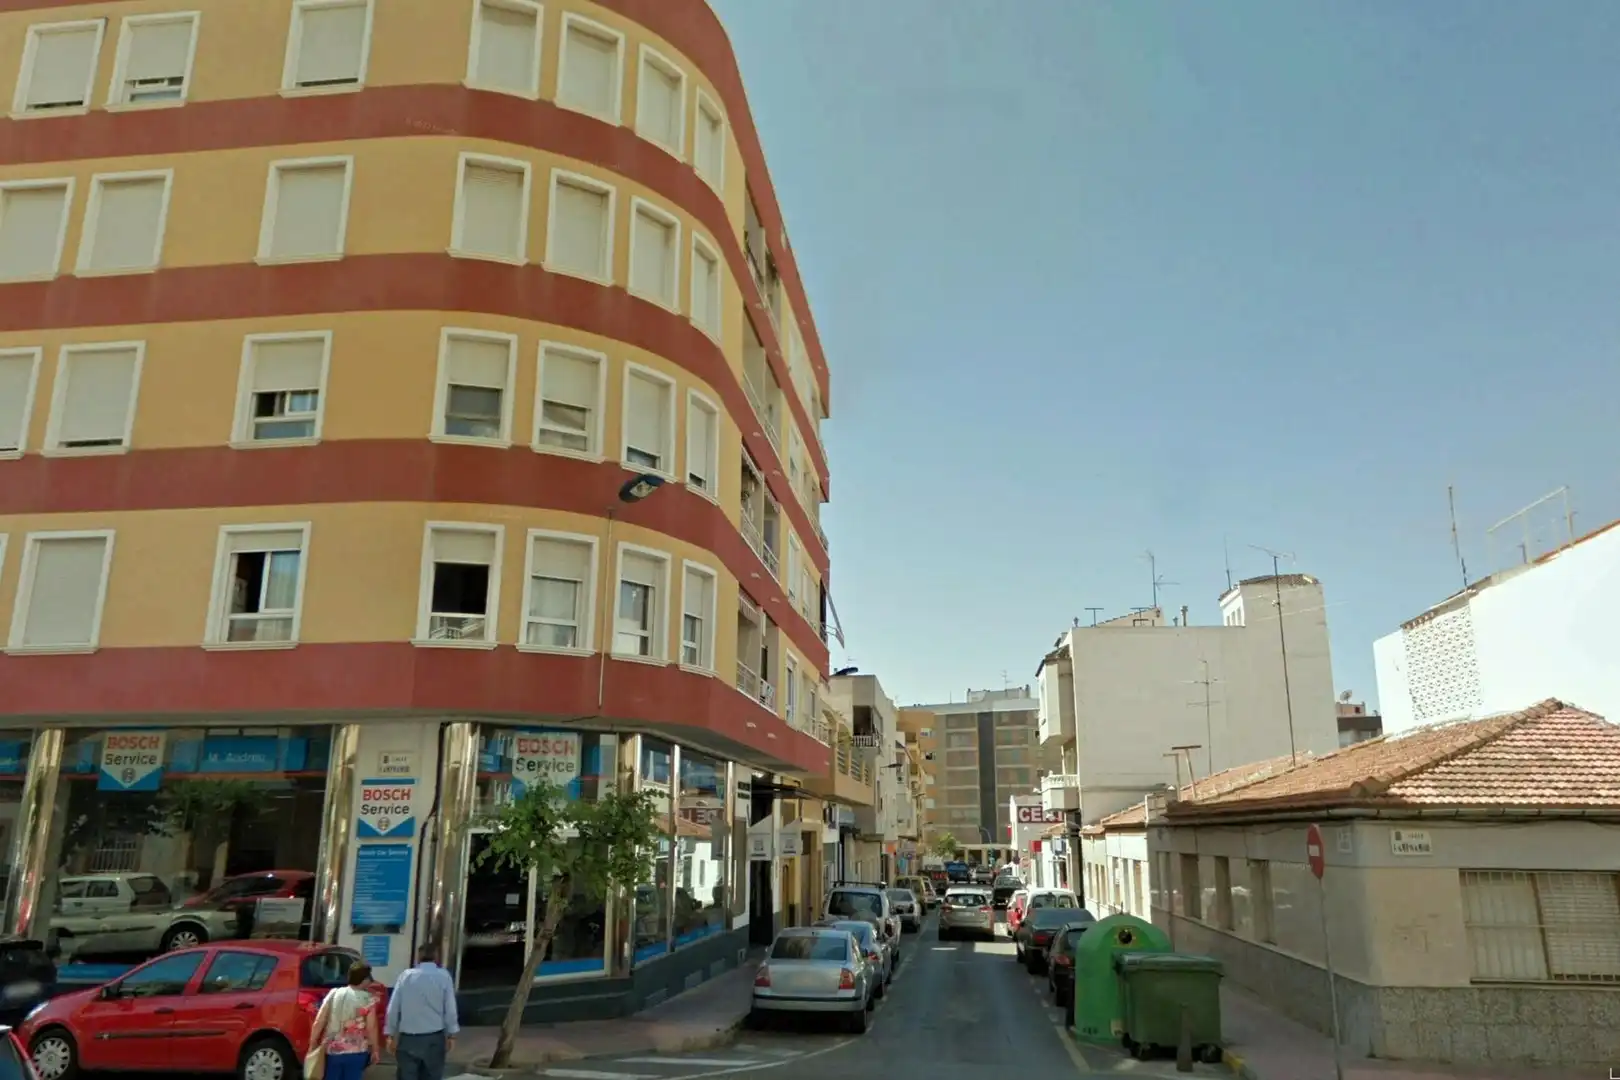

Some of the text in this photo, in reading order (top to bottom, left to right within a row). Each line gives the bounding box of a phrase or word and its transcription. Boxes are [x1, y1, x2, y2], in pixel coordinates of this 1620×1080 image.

[107, 735, 160, 750] BOSCH
[517, 737, 575, 756] BOSCH
[104, 753, 158, 766] Service
[515, 756, 575, 773] Service
[362, 788, 412, 801] BOSCH
[360, 802, 410, 815] Service
